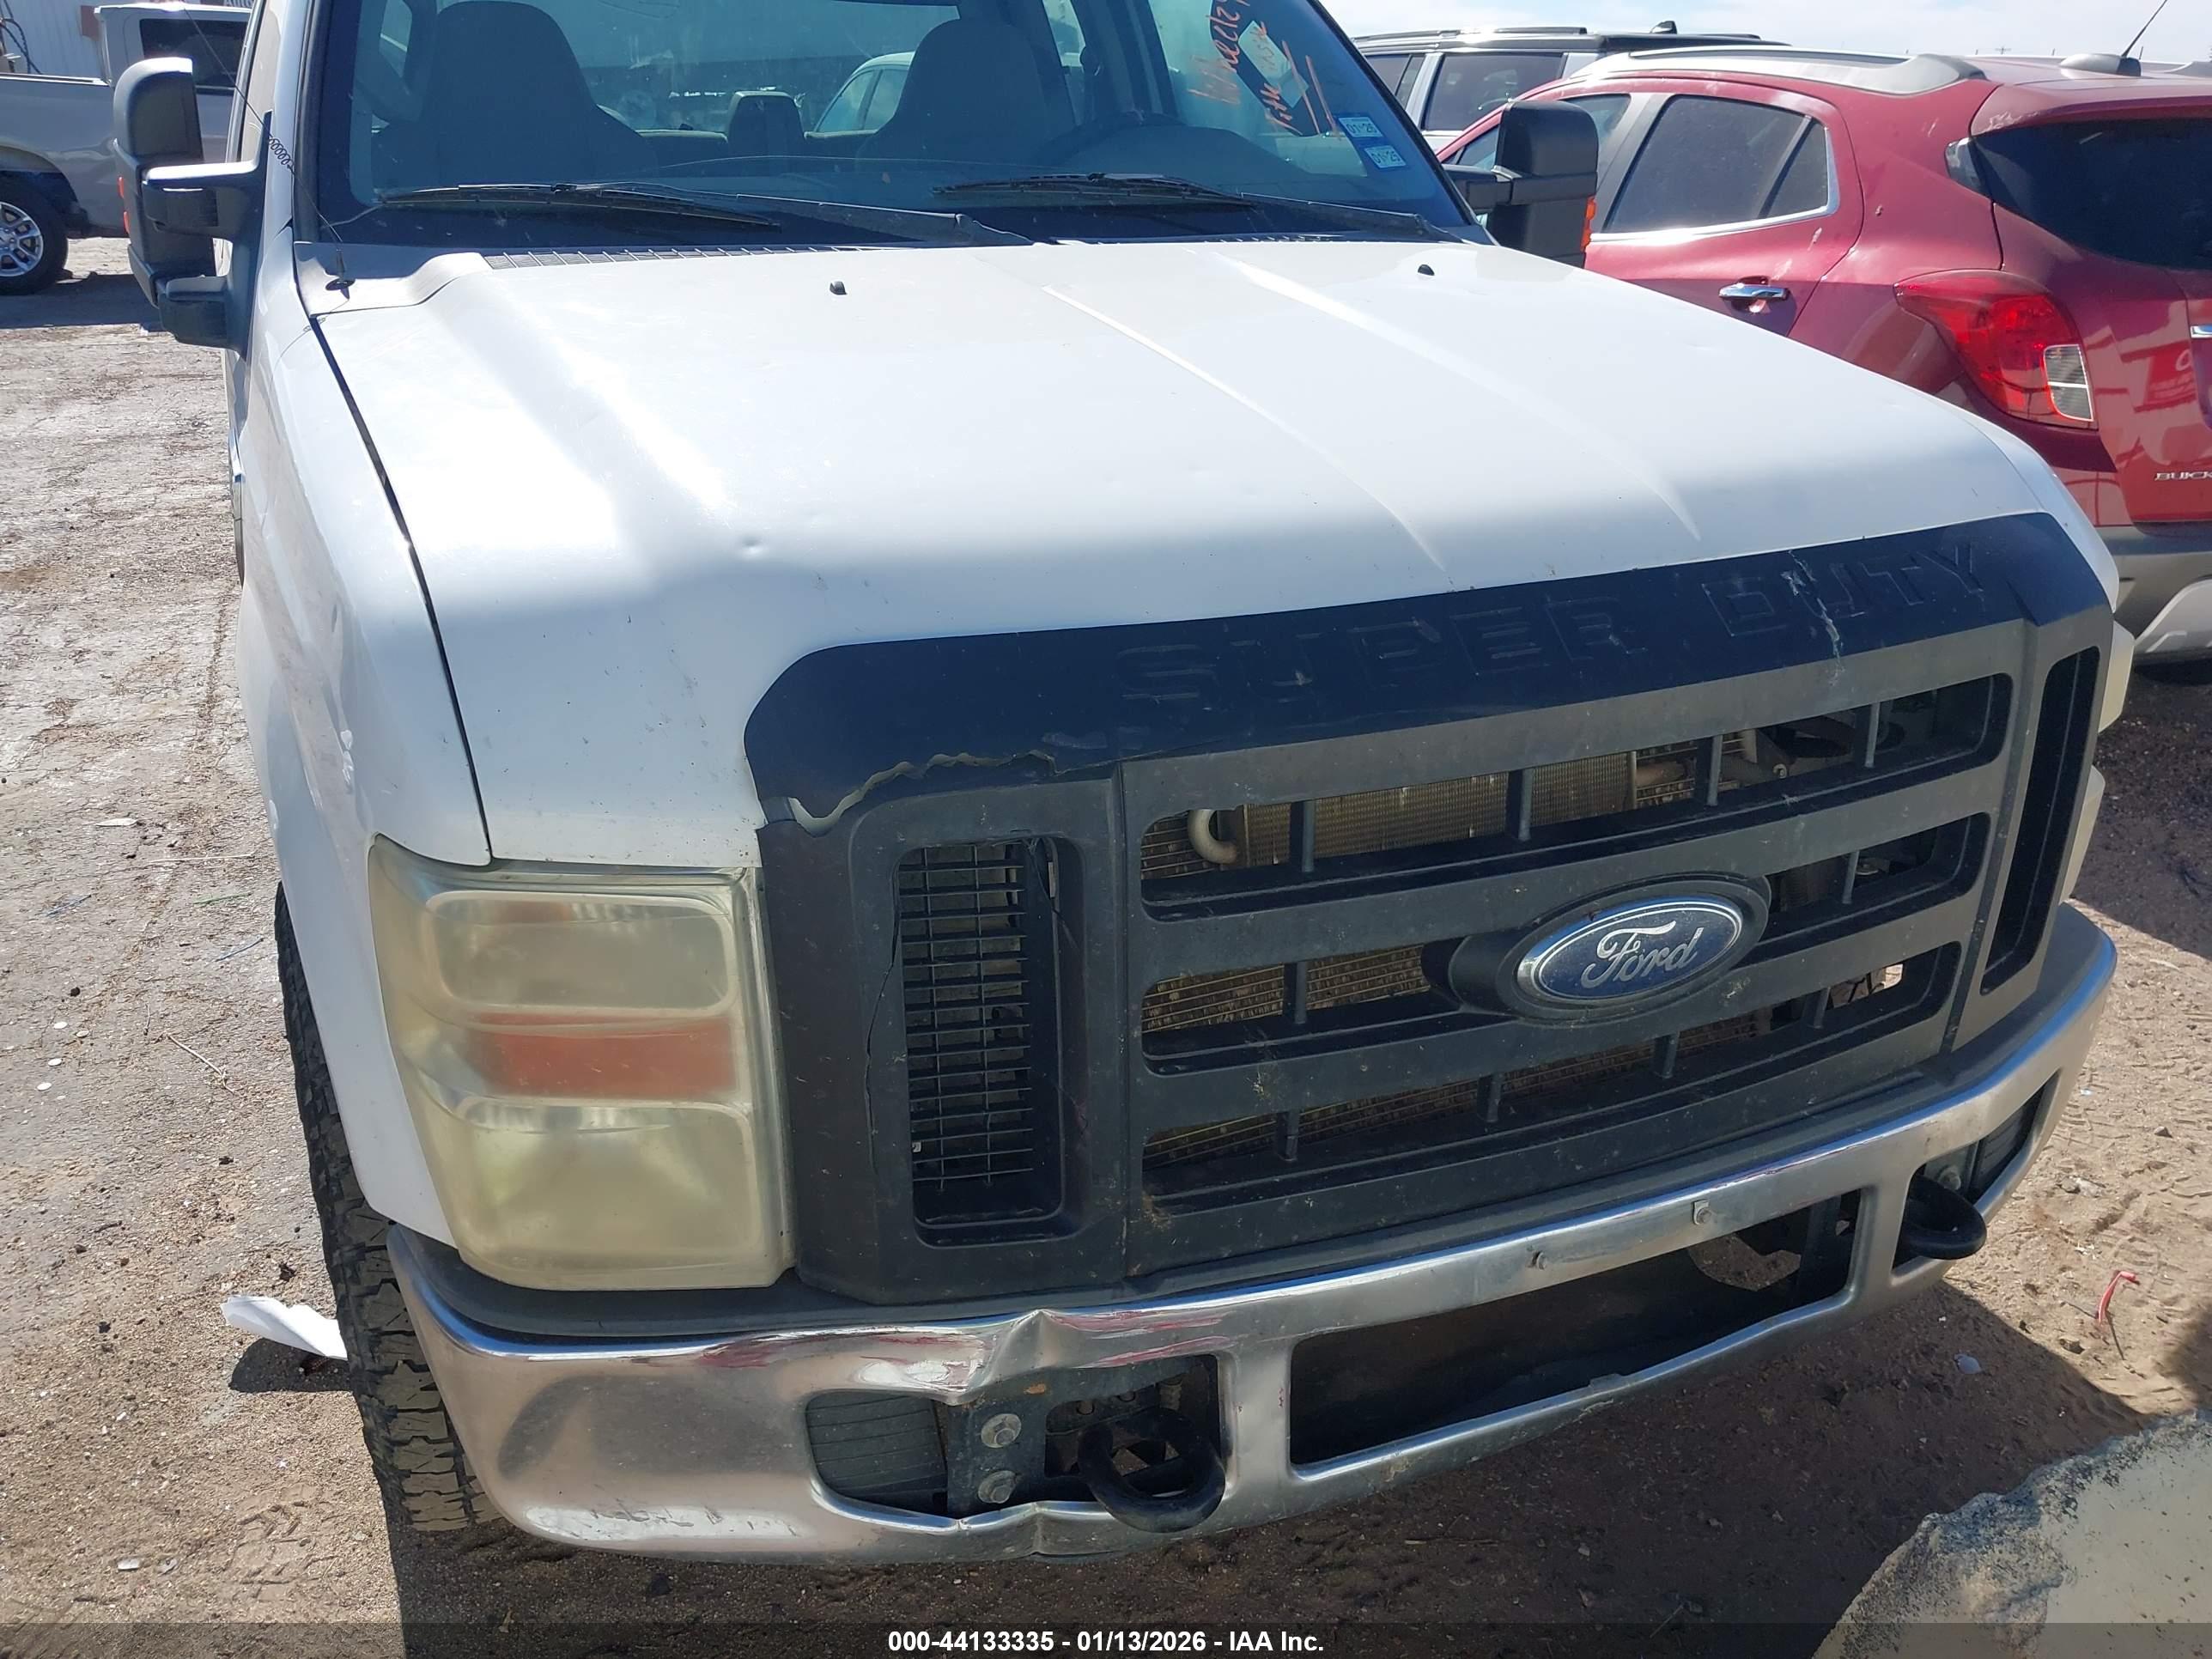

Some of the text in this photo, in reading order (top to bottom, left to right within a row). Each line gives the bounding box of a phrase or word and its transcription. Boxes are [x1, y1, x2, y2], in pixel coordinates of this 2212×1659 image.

[1115, 544, 1984, 705] SUPER DUTY
[1580, 921, 1705, 988] Ford
